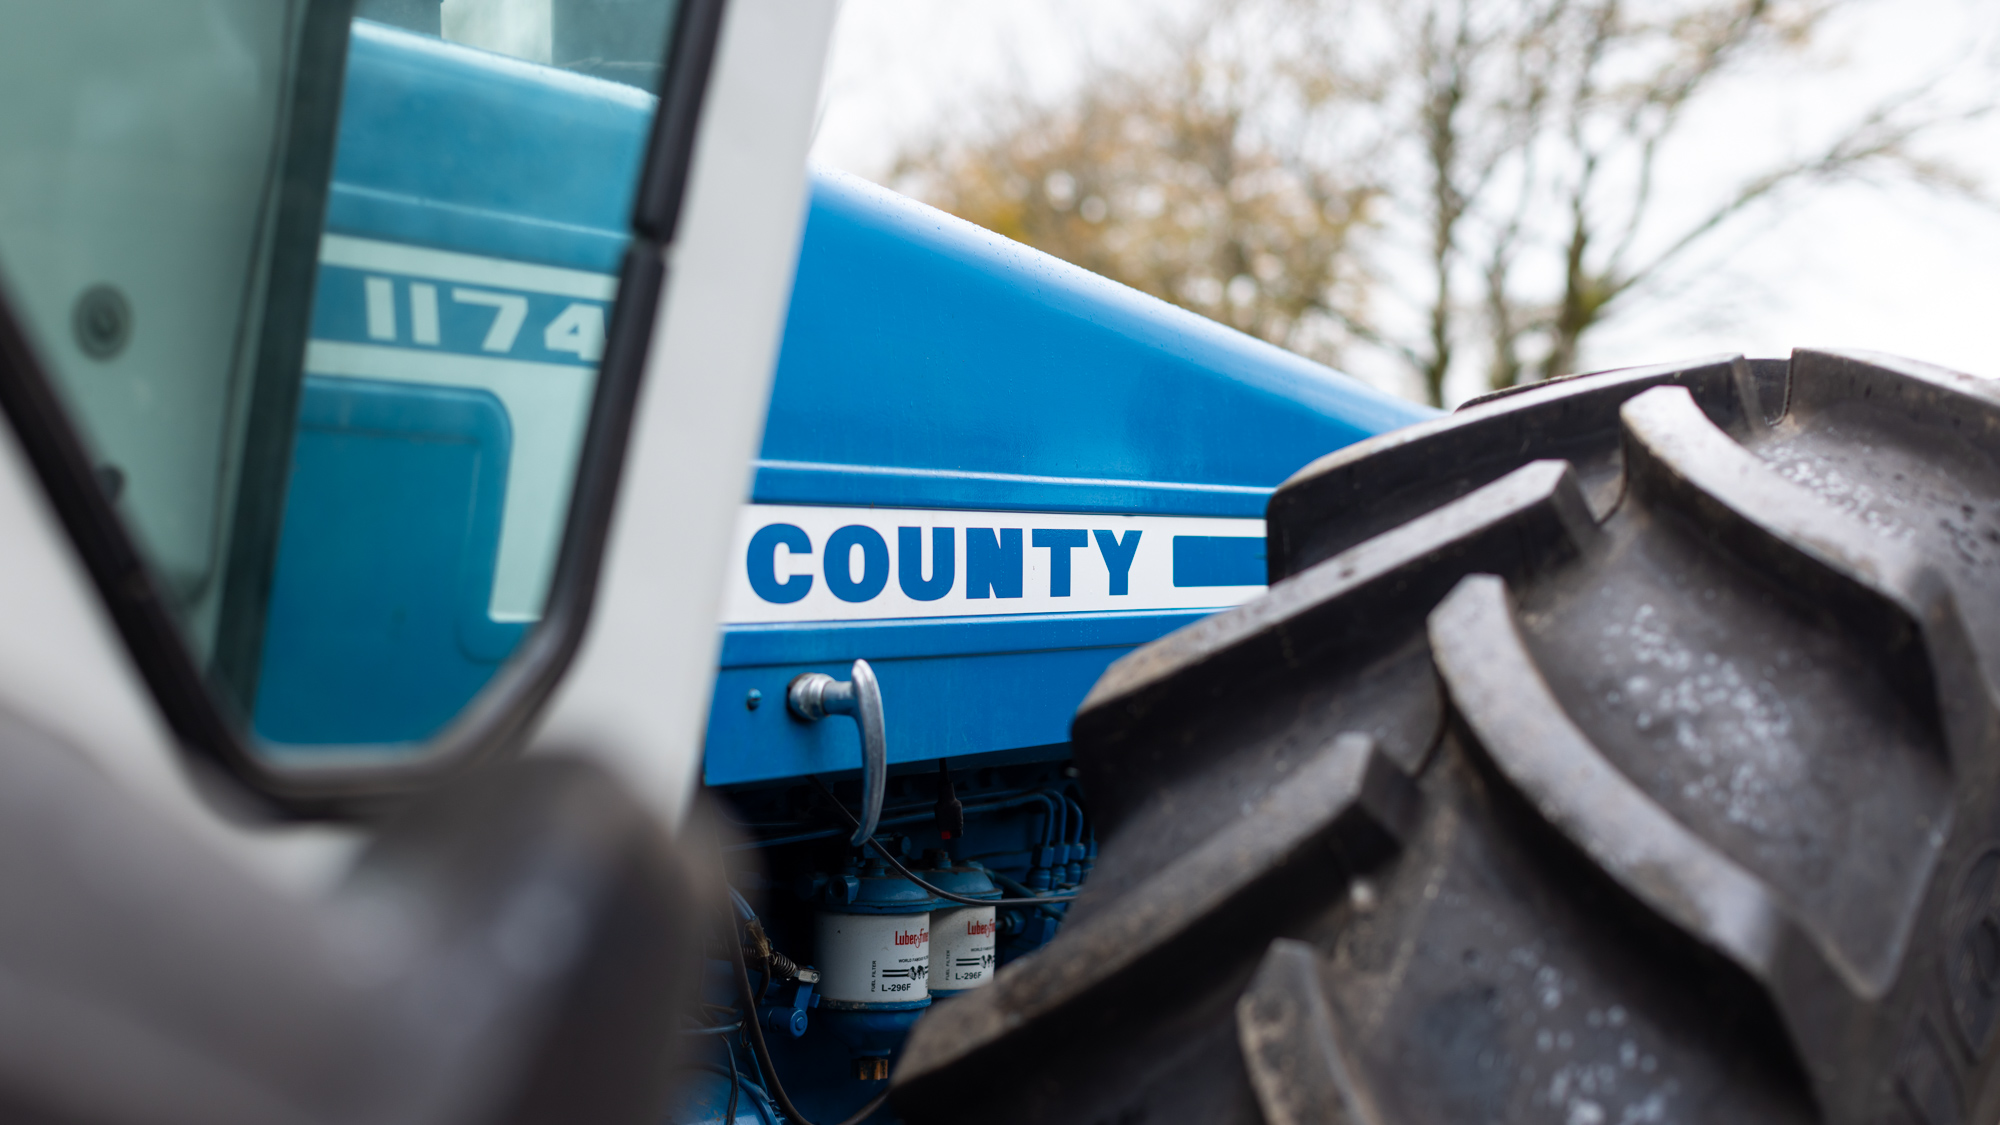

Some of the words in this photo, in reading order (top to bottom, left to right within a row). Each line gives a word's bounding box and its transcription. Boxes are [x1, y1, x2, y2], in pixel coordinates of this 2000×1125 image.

[365, 276, 605, 361] 1174
[746, 523, 1143, 604] COUNTY
[881, 983, 911, 992] L-296F
[955, 971, 982, 980] L-296F
